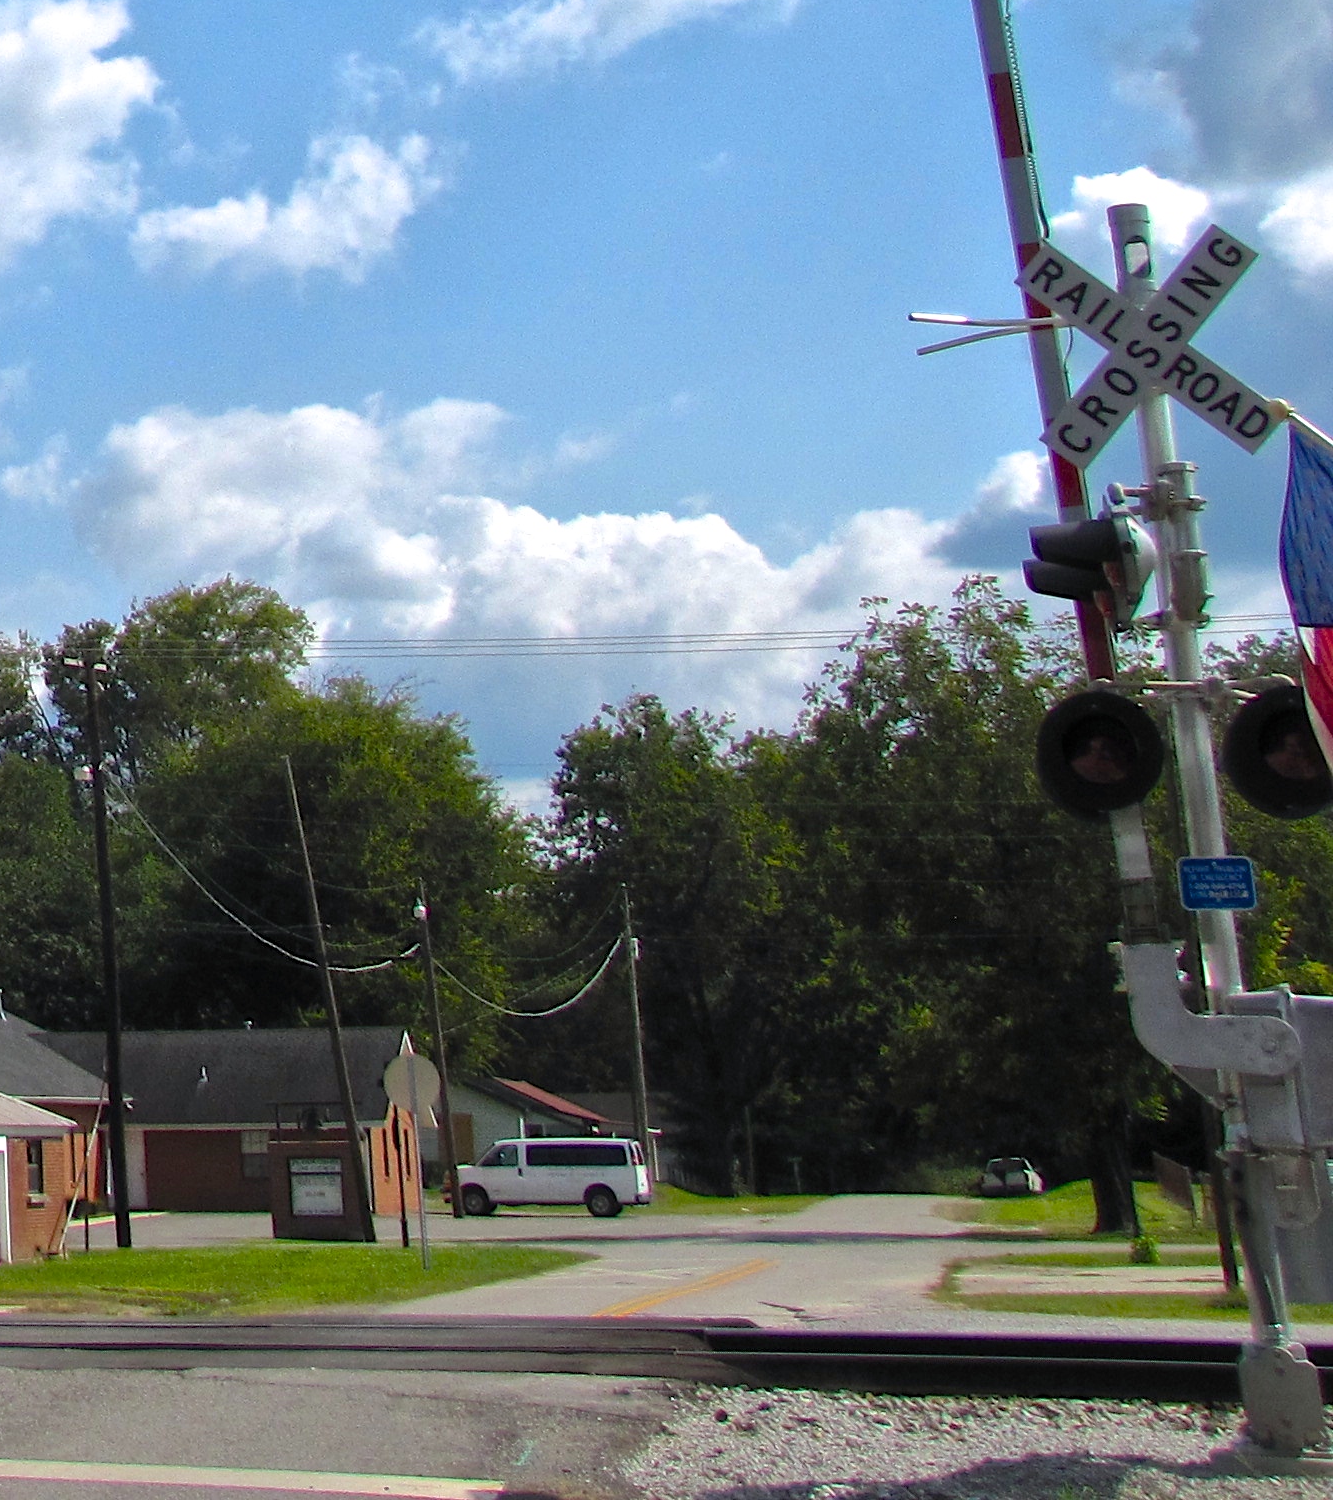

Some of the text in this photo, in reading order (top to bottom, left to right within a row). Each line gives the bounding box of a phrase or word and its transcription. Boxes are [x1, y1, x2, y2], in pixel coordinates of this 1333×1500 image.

[1030, 257, 1269, 438] RAIL ROAD
[1058, 238, 1242, 453] CROSSING
